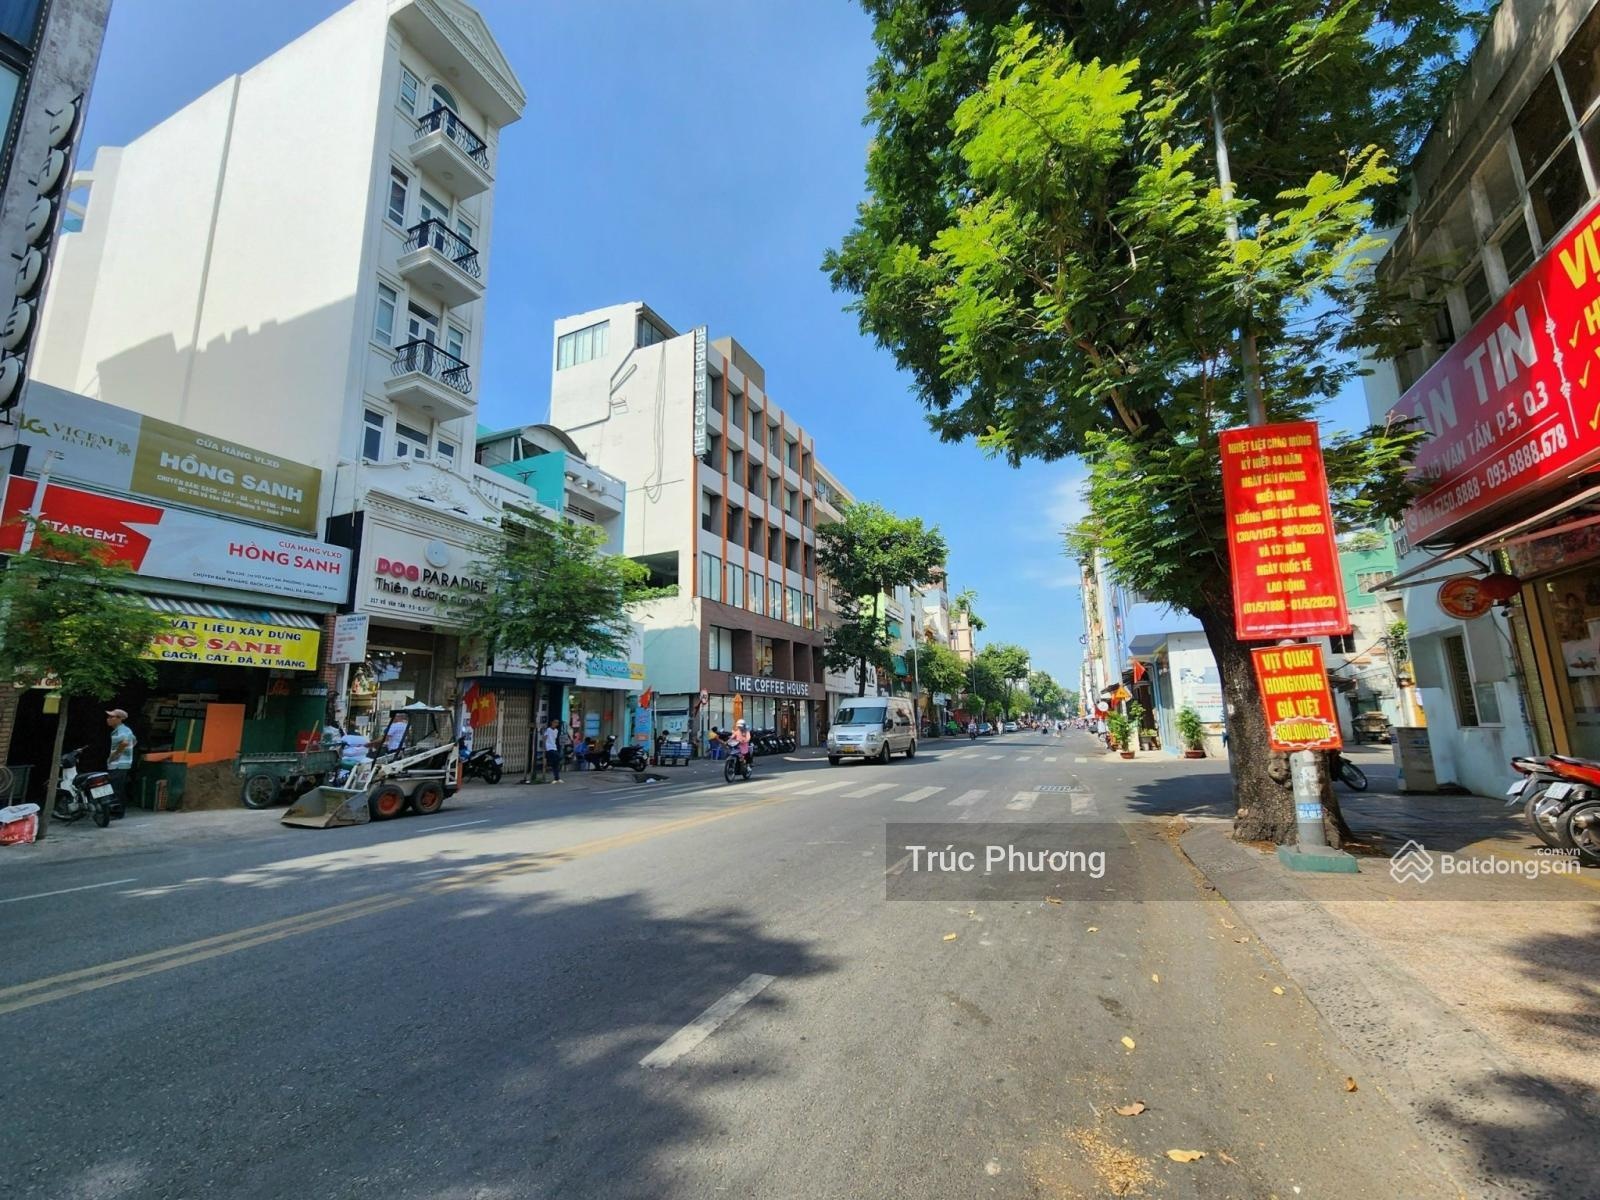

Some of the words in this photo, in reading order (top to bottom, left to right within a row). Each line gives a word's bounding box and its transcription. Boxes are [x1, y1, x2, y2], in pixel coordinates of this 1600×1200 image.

[1558, 214, 1600, 289] VỊ
[695, 326, 707, 371] HOUSE
[1523, 380, 1549, 417] Q.3
[53, 422, 114, 447] VICEM
[694, 426, 706, 455] THE
[254, 456, 280, 469] VLXD
[1486, 422, 1568, 490] 093.8888.678
[159, 450, 235, 485] HỒNG
[241, 474, 304, 502] SANH
[229, 540, 289, 566] HỒNG
[294, 555, 341, 575] SANH
[375, 557, 420, 582] DOG
[423, 567, 488, 595] PARADISE
[375, 577, 409, 596] Thiên
[203, 622, 235, 635] LIỆU
[239, 626, 264, 637] XÂY
[207, 638, 283, 655] SANH
[261, 657, 272, 666] XI
[1261, 652, 1281, 674] VỊT
[1282, 649, 1314, 670] QUAY
[734, 676, 752, 692] THE
[755, 678, 785, 695] COFFEE
[786, 683, 809, 697] HOUSE
[1263, 673, 1325, 695] HONGKONG
[1276, 696, 1297, 719] GIÁ
